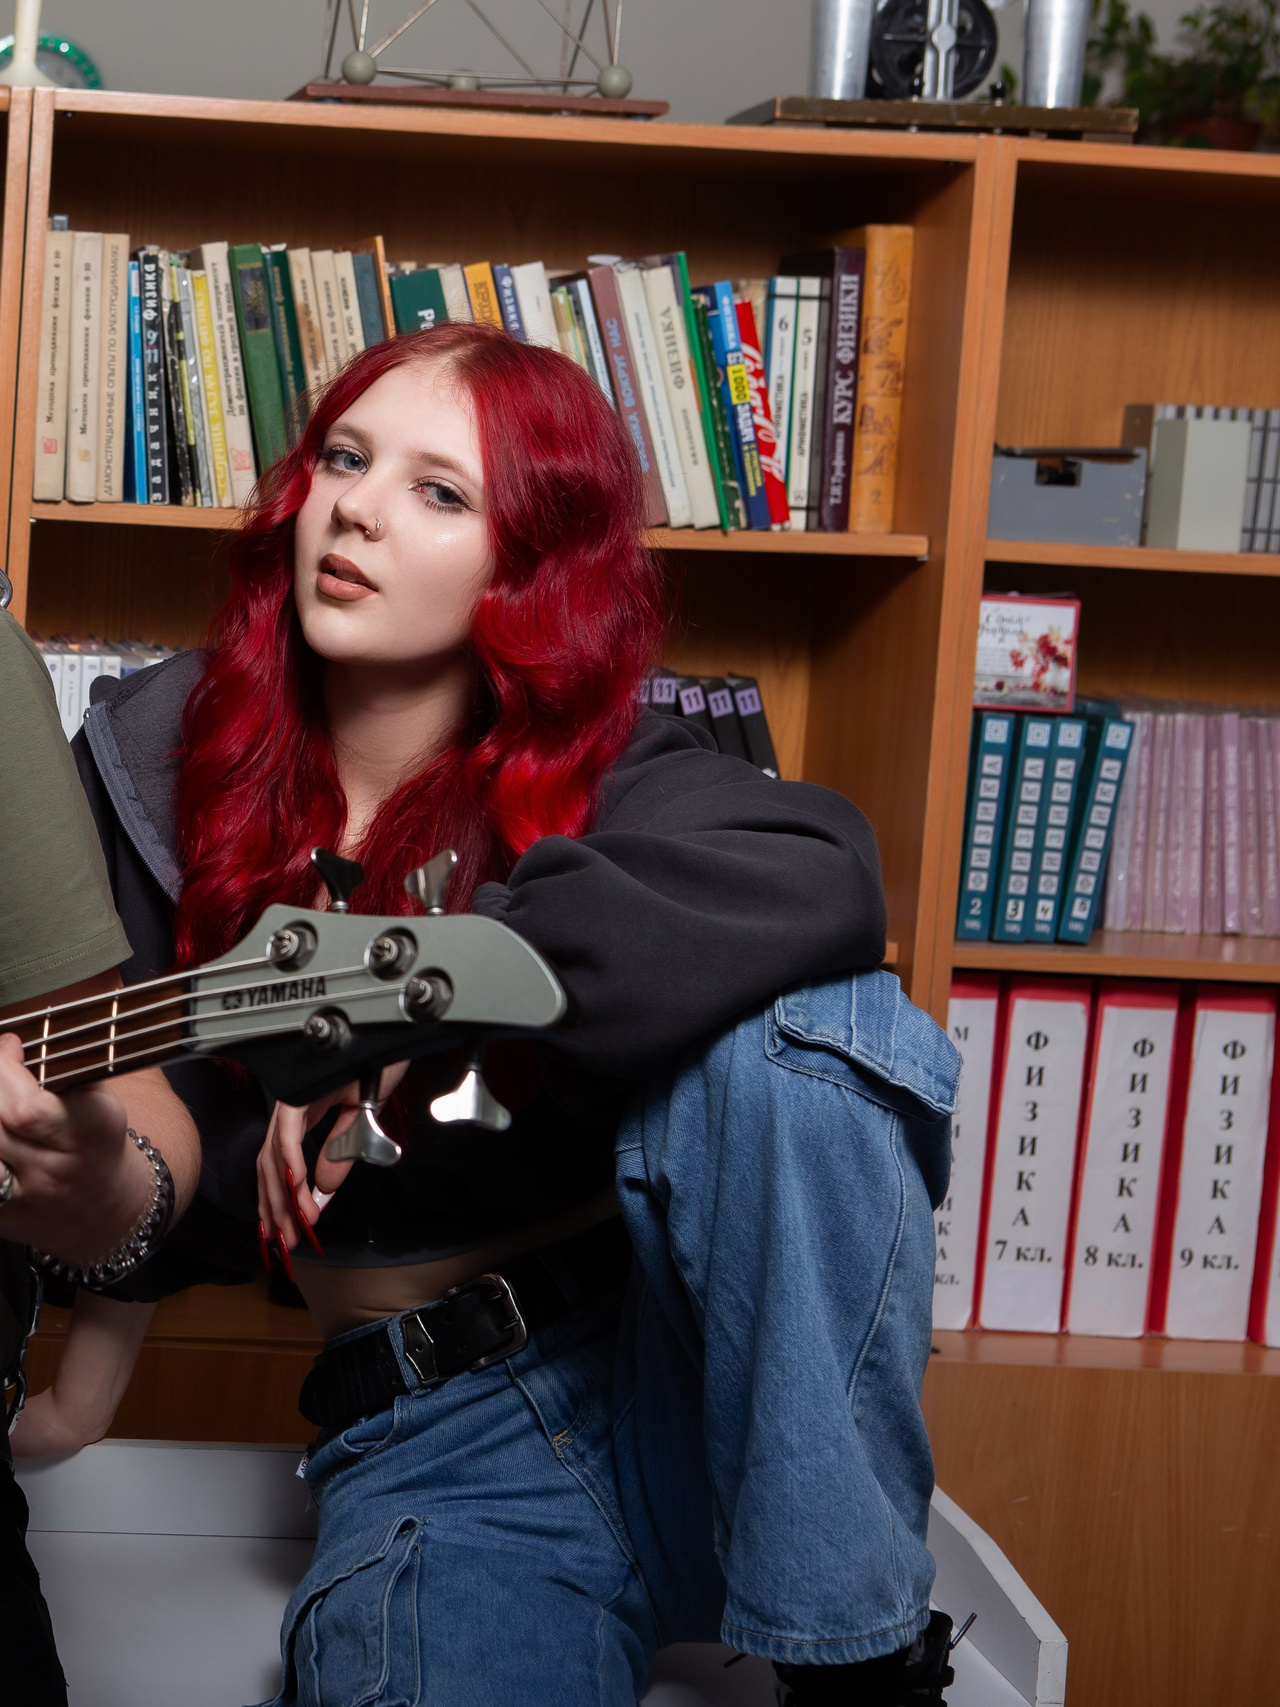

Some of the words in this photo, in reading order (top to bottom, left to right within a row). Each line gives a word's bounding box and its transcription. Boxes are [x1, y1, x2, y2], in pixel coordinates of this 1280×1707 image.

[108, 243, 120, 336] ЭЛЕКТРОДИНАМИКЕ
[210, 261, 225, 322] эксперимент
[195, 288, 210, 346] ФИЗИКЕ
[606, 317, 622, 348] НАС
[778, 316, 789, 332] 6
[835, 273, 860, 365] ФИЗИКИ
[108, 338, 116, 352] ПО
[228, 316, 243, 354] средней
[659, 305, 685, 391] ФИЗИКА
[107, 353, 117, 389] ОПЫТЫ
[202, 348, 213, 371] ПО
[216, 324, 236, 417] Демонстрационный
[205, 372, 218, 417] ЗАДАЧ
[233, 366, 246, 401] физике
[614, 353, 635, 408] ВОКРУГ
[833, 369, 855, 425] КУРС
[236, 404, 246, 417] по
[735, 402, 754, 443] ЗАДАЧ
[103, 391, 116, 496] ДЕМОНСТРАЦИОННЫЕ
[685, 692, 700, 708] 11
[712, 695, 728, 711] 11
[740, 694, 756, 710] 11
[970, 898, 982, 915] 2
[1007, 901, 1020, 920] 3
[1039, 902, 1051, 918] 4
[247, 976, 327, 1006] YAMAHA
[1012, 1031, 1049, 1227] ФИЗИКА
[1113, 1037, 1155, 1233] ФИЗИКА
[1207, 1040, 1247, 1236] ФИЗИКА
[995, 1240, 1008, 1261] 7
[1016, 1247, 1053, 1263] кл.
[1084, 1245, 1099, 1266] 8
[1106, 1252, 1143, 1269] кл.
[1179, 1248, 1194, 1268] 9
[1202, 1254, 1240, 1270] кл.
